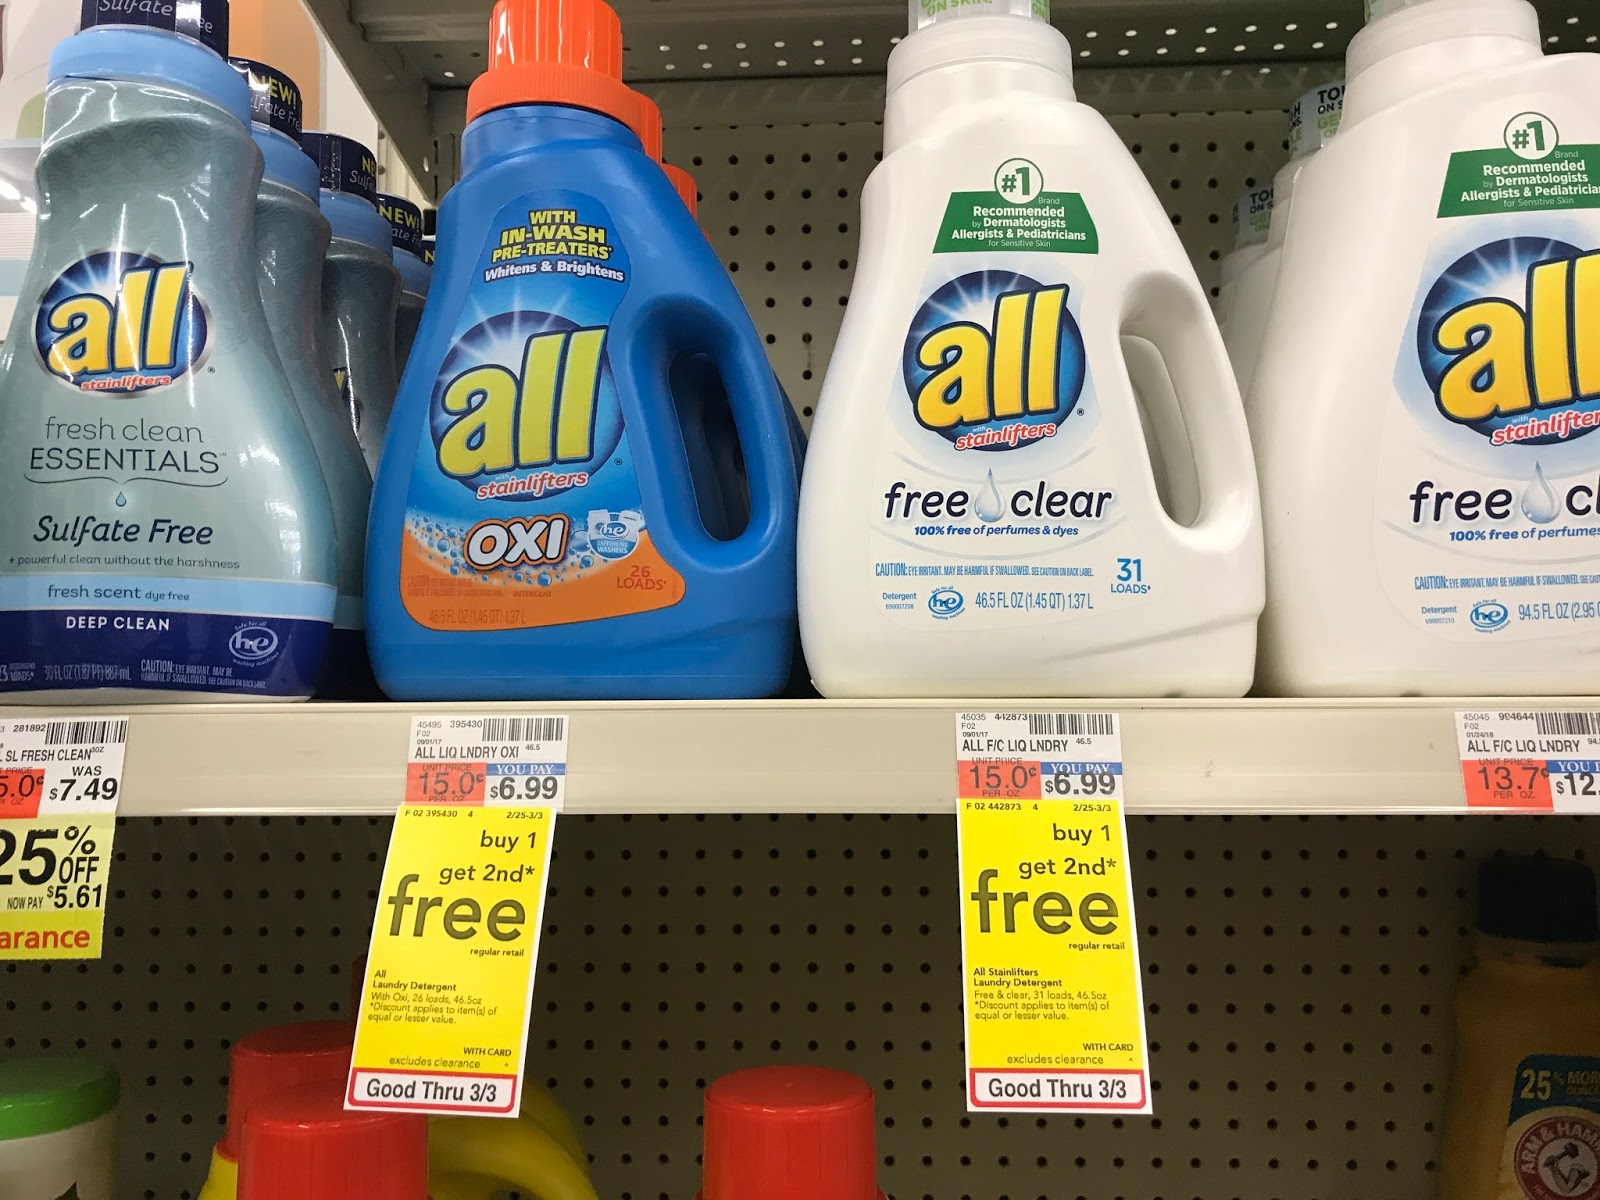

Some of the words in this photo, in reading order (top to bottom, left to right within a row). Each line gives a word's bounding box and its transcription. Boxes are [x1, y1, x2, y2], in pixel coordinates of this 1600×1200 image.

[1512, 120, 1545, 151] #1
[1483, 160, 1585, 176] Recommended
[1001, 167, 1031, 196] #1
[1496, 173, 1588, 187] Dermatologists
[1460, 188, 1520, 202] Allergists
[1535, 183, 1600, 197] Pediatricia
[1038, 196, 1060, 205] Brand
[1518, 198, 1554, 208] Sensitive
[379, 203, 420, 232] NEW!
[530, 210, 577, 225] WITH
[973, 205, 1065, 218] Recommended
[983, 217, 1066, 230] Dermatologists
[501, 226, 605, 246] IN-WASH
[952, 229, 1004, 242] Allergists
[1006, 230, 1014, 239] &
[1016, 229, 1086, 241] Pediatricians
[1001, 239, 1034, 248] Sensitive
[485, 261, 537, 282] Whitens
[541, 261, 552, 272] &
[557, 260, 624, 282] Brightens
[46, 262, 194, 376] all
[913, 283, 1070, 432] all
[81, 374, 172, 392] stainlifters
[436, 325, 609, 479] all
[45, 416, 115, 440] fresh
[122, 418, 204, 443] clean
[1491, 410, 1600, 445] stainlifter
[955, 422, 1057, 450] stainlifters
[477, 472, 588, 499] stainlifters
[884, 481, 969, 519] free
[1010, 480, 1113, 519] clear
[1408, 479, 1512, 523] free
[33, 515, 141, 547] Sulfate
[149, 518, 213, 545] Free
[914, 525, 945, 537] 100%
[946, 525, 971, 536] free
[973, 525, 985, 537] of
[986, 525, 1041, 538] perfumes
[1042, 526, 1051, 536] &
[1052, 525, 1079, 538] dyes
[1450, 530, 1486, 541] 100%
[1489, 529, 1519, 540] free
[467, 517, 566, 566] OXI
[18, 554, 66, 567] powerful
[69, 555, 101, 565] clean
[104, 555, 151, 566] without
[154, 556, 174, 566] the
[177, 557, 240, 569] harshness
[630, 565, 651, 578] 26
[875, 562, 908, 577] CAUTION:
[1116, 557, 1142, 582] 31
[1414, 575, 1449, 590] CAUTION:
[48, 584, 89, 599] fresh
[94, 586, 141, 600] scent
[145, 589, 165, 602] dye
[882, 592, 917, 601] Detergent
[975, 591, 995, 609] 46.5
[998, 591, 1009, 609] FL
[1011, 591, 1024, 609] OZ
[1025, 592, 1047, 612] (1.45
[1049, 592, 1066, 612] QT)
[1068, 592, 1086, 609] 1.37
[1421, 605, 1457, 615] Detergent
[1518, 604, 1540, 621] 94.5
[66, 616, 107, 630] DEEP
[113, 616, 170, 631] CLEAN
[141, 659, 174, 674] CAUTION:
[450, 720, 483, 729] 395430
[961, 713, 986, 721] 45035
[994, 713, 1028, 721] 442873
[13, 723, 46, 733] 281892
[415, 746, 435, 759] ALL
[439, 747, 457, 759] LIQ
[460, 746, 497, 759] LNDRY
[500, 746, 519, 759] OXI
[962, 739, 984, 752] ALL
[986, 739, 1005, 752] F/C
[1008, 739, 1027, 752] LIQ
[1029, 739, 1068, 752] LNDRY
[1467, 739, 1490, 752] ALL
[1493, 739, 1512, 752] F/C
[1516, 739, 1536, 753] LIQ
[1540, 739, 1580, 752] LNDRY
[21, 749, 55, 763] FRESH
[57, 748, 91, 762] CLEAN
[72, 765, 102, 777] WAS
[496, 764, 527, 775] YOU
[530, 764, 554, 775] PAY
[1051, 763, 1082, 774] YOU
[1085, 763, 1110, 774] PAY
[1557, 761, 1590, 772] YOU
[50, 777, 118, 801] $7.49
[490, 776, 558, 800] $6.99
[1045, 771, 1115, 795] $6.99
[1556, 771, 1600, 796] $12.
[480, 830, 519, 853] buy
[527, 831, 537, 848] 1
[1052, 823, 1092, 846] buy
[1100, 824, 1111, 841] 1
[59, 856, 99, 884] OFF
[439, 865, 476, 885] get
[1019, 859, 1056, 879] get
[7, 897, 26, 910] NOW
[28, 896, 43, 910] PAY
[47, 884, 103, 909] $5.61
[970, 868, 1119, 935] free
[388, 873, 526, 942] free
[0, 929, 90, 949] arance
[1068, 941, 1100, 951] regular
[1102, 941, 1125, 950] retail
[470, 948, 500, 957] regular
[502, 948, 524, 957] retail
[988, 967, 1039, 977] Stainlifters
[372, 979, 408, 991] Laundry
[410, 981, 457, 993] Detergent
[973, 978, 1011, 988] Laundry
[1013, 978, 1063, 989] Detergent
[974, 990, 994, 1000] Free
[1006, 990, 1031, 1001] clear,
[1033, 991, 1044, 1000] 31
[1047, 991, 1074, 1001] loads,
[1076, 991, 1107, 1000] 46.5oz
[1021, 1001, 1054, 1012] applies
[1068, 1001, 1098, 1012] item(s)
[974, 1011, 1000, 1022] equal
[1014, 1011, 1040, 1020] lesser
[1042, 1011, 1069, 1021] value.
[463, 1046, 486, 1056] WITH
[487, 1047, 512, 1057] CARD
[1082, 1043, 1107, 1051] WITH
[1108, 1043, 1134, 1051] CARD
[389, 1055, 432, 1067] excludes
[434, 1057, 480, 1069] clearance
[1006, 1053, 1053, 1064] excludes
[1055, 1054, 1104, 1064] clearance
[1567, 1070, 1600, 1084] MOR
[366, 1077, 417, 1099] Good
[421, 1080, 464, 1101] Thru
[469, 1082, 497, 1103] 3/3
[988, 1077, 1042, 1098] Good
[1046, 1078, 1093, 1098] Thru
[1098, 1079, 1127, 1099] 3/3
[1520, 1135, 1544, 1175] ARM
